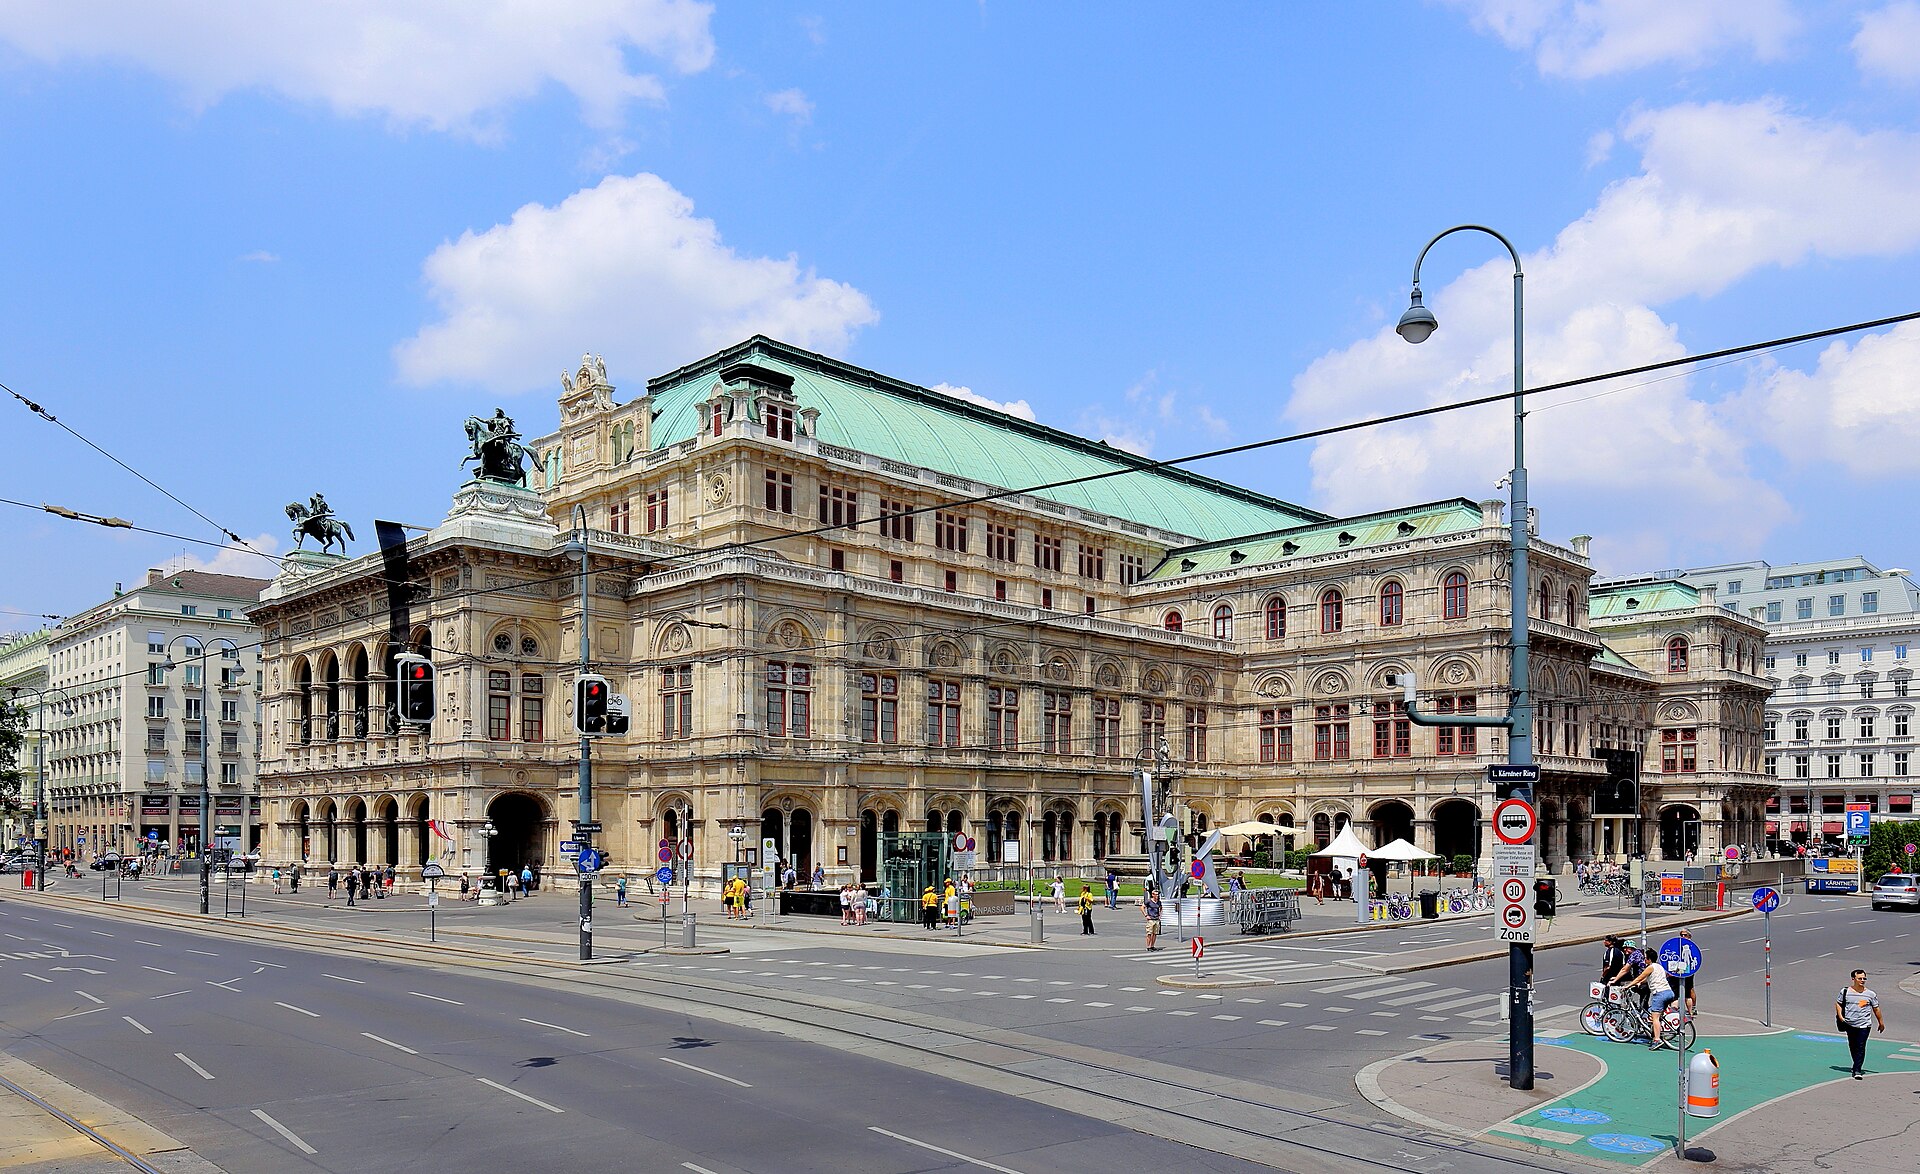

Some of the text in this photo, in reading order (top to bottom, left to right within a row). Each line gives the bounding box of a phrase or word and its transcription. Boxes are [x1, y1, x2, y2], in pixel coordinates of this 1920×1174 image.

[1498, 769, 1522, 778] Kärntner
[1522, 769, 1536, 779] Ring
[1509, 886, 1520, 896] 30
[1500, 928, 1530, 941] Zone
